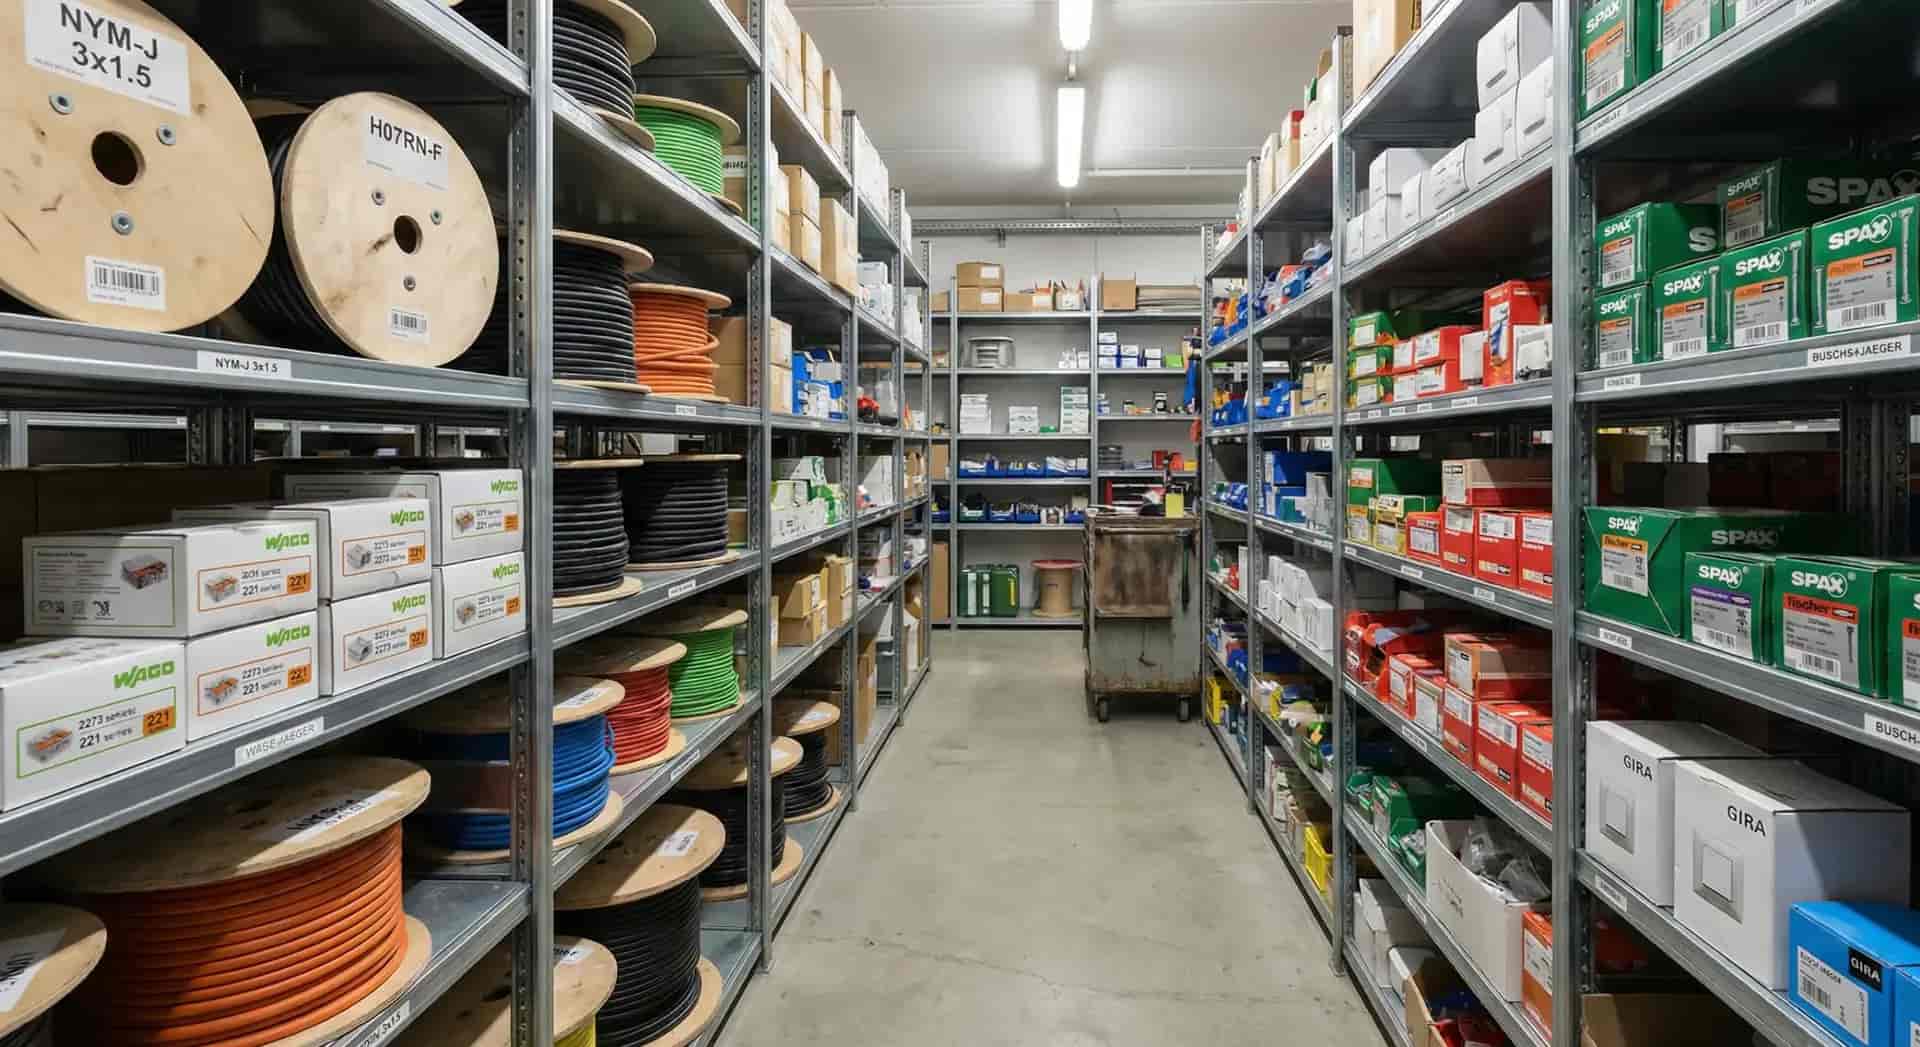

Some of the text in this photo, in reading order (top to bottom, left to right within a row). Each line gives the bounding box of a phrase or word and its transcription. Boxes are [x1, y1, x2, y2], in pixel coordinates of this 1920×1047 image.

[60, 2, 158, 61] NYM-J
[72, 41, 152, 88] 3x1.5
[370, 115, 443, 161] H07RN-F
[1728, 176, 1760, 196] SPAX
[1604, 217, 1632, 237] SPAX
[1828, 218, 1888, 250] SPAX
[1736, 250, 1781, 276] SPAX
[1664, 275, 1702, 296] SPAX
[1600, 296, 1628, 315] SPAX
[215, 357, 250, 371] NYM-J
[390, 508, 425, 526] WAGO
[1608, 515, 1637, 530] SPAX
[264, 533, 310, 553] WAGO
[1711, 529, 1776, 545] SPAX
[1698, 564, 1739, 586] SPAX
[1791, 570, 1844, 594] SPAX
[242, 584, 258, 596] 221
[392, 594, 426, 613] WAGO
[266, 624, 311, 647] WAGO
[113, 660, 176, 689] WAGO
[242, 682, 259, 696] 221
[78, 714, 104, 731] 2273
[148, 710, 170, 728] 221
[79, 733, 101, 749] 221
[1623, 754, 1653, 782] GIRA
[1727, 804, 1767, 837] GIRA
[1850, 957, 1881, 983] GIRA
